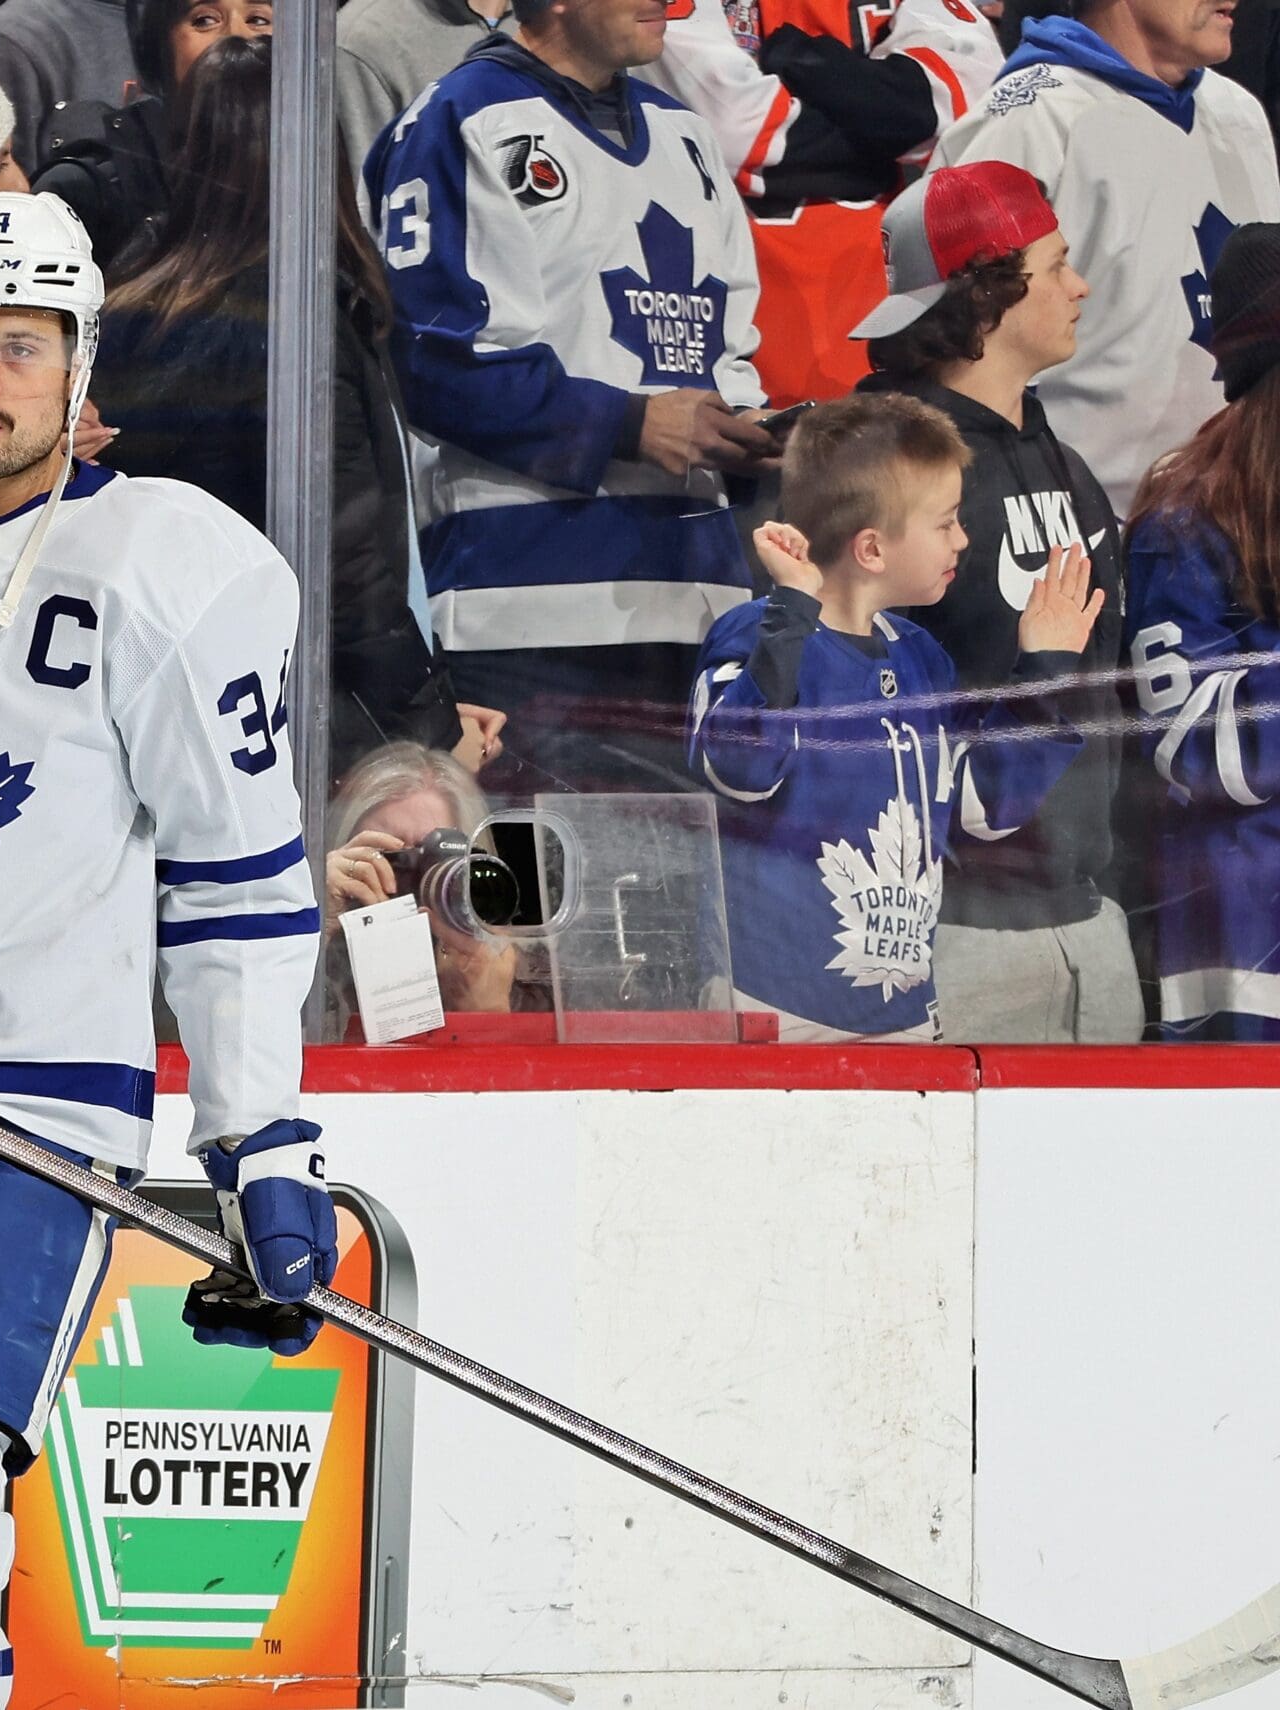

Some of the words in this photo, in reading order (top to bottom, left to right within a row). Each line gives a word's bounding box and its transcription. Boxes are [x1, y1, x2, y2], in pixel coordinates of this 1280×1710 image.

[623, 289, 715, 323] TORONTO
[646, 318, 705, 349] MAPLE
[653, 345, 704, 375] LEAFS
[25, 593, 99, 690] C
[850, 885, 934, 925] TORONTO
[866, 912, 922, 939] MAPLE
[863, 935, 921, 963] LEAFS
[106, 1420, 312, 1453] PENNSYLVANIA
[103, 1458, 312, 1508] LOTTERY
[263, 1639, 282, 1655] TM
